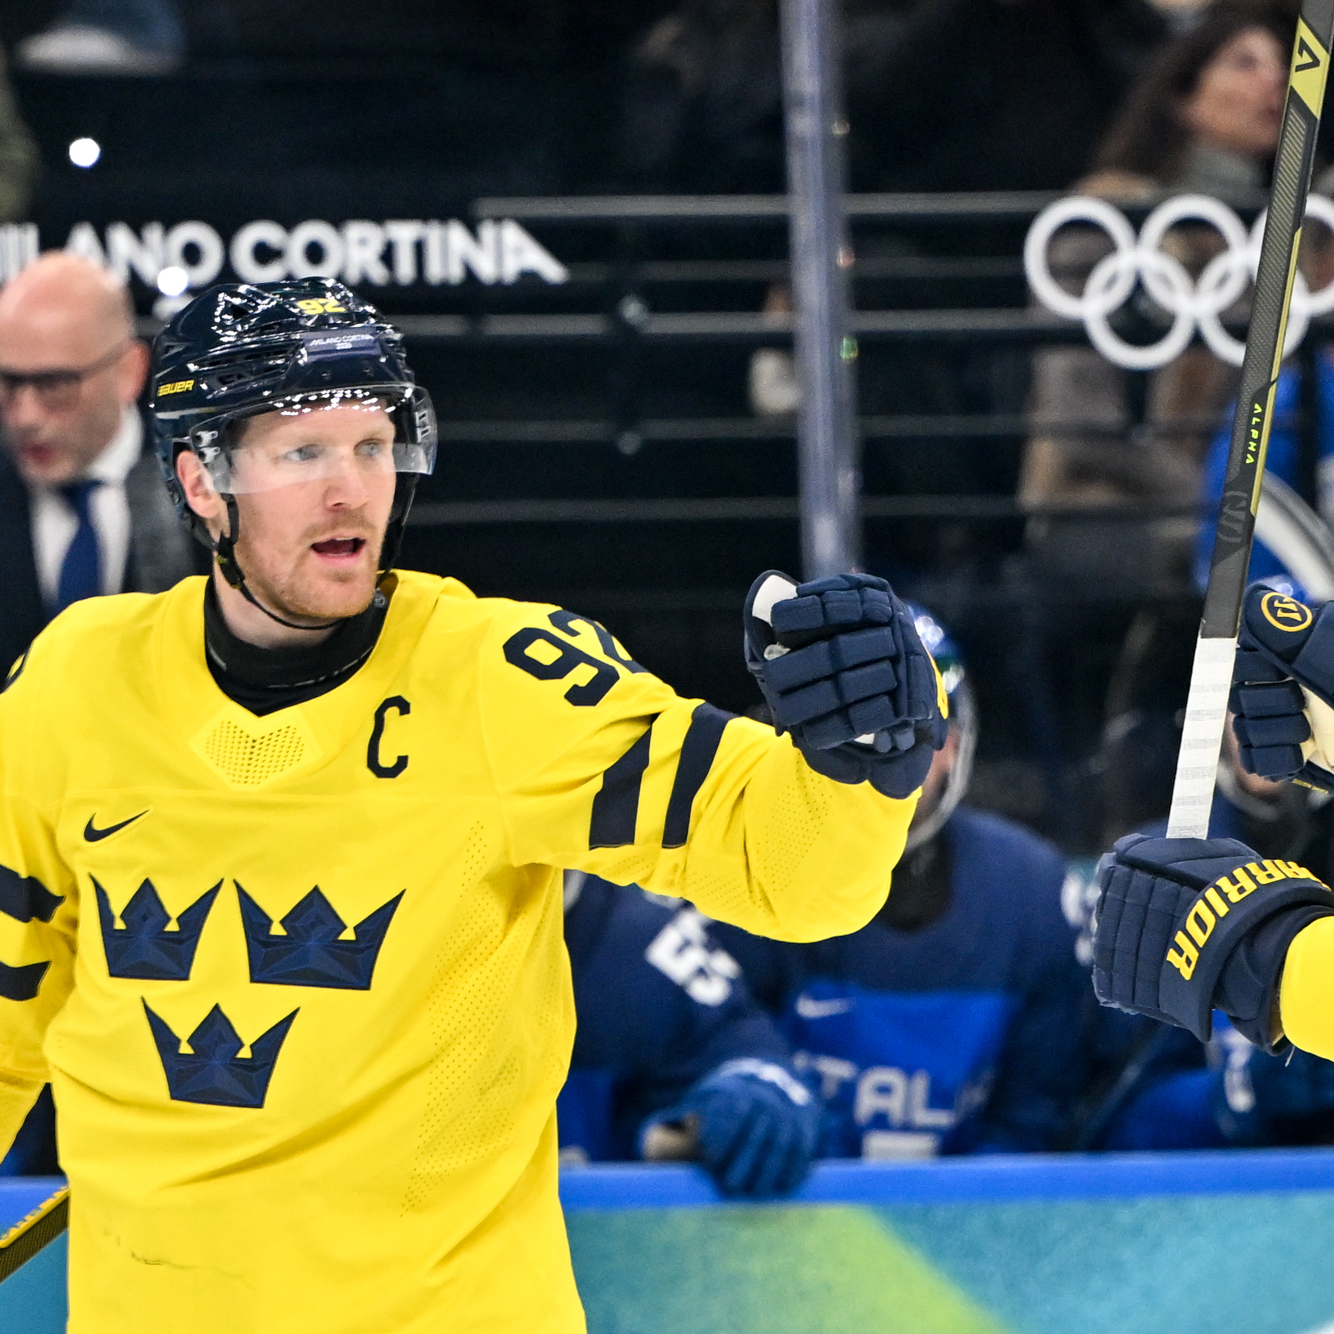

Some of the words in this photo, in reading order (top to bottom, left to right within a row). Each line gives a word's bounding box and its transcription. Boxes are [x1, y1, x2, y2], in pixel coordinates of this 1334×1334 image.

[228, 218, 569, 287] CORTINA
[296, 297, 347, 315] 92
[365, 695, 411, 779] C
[1165, 858, 1333, 982] ARRIOR
